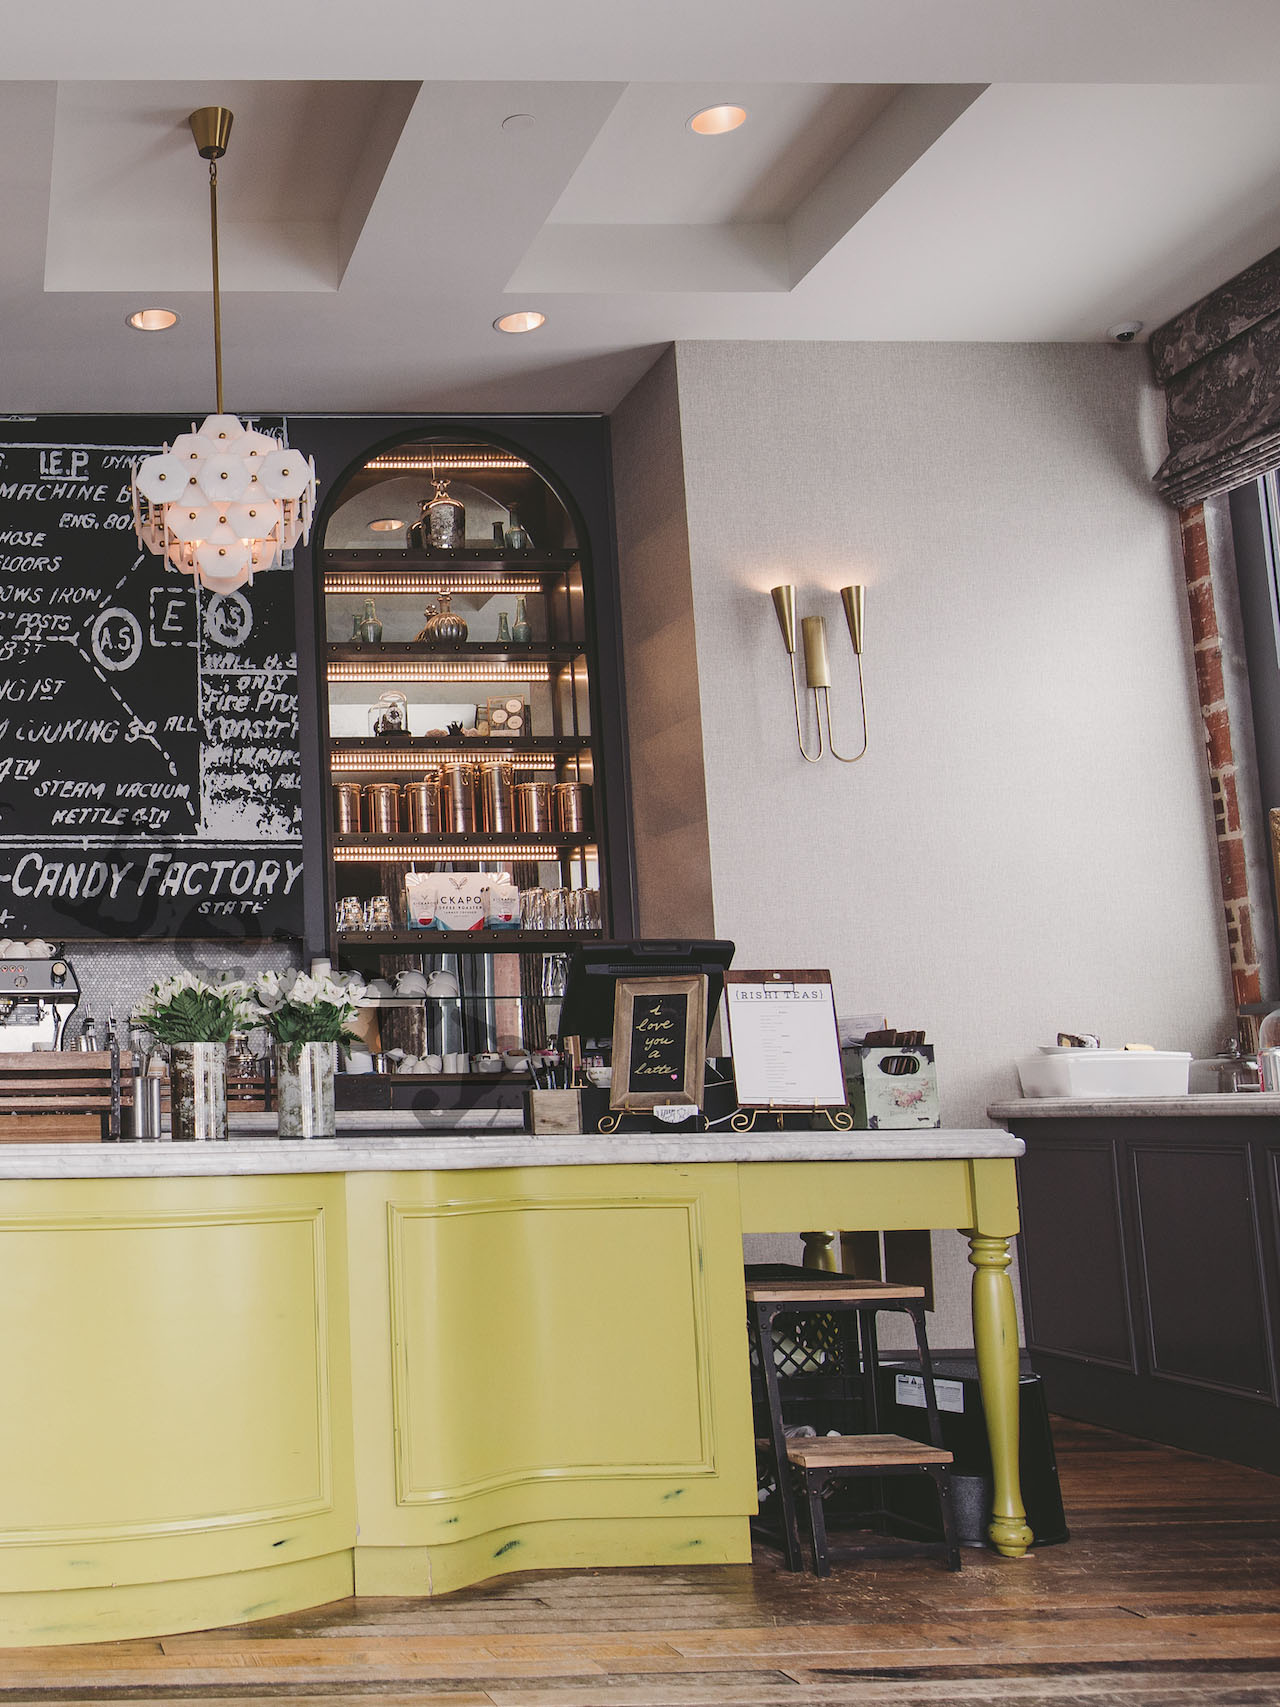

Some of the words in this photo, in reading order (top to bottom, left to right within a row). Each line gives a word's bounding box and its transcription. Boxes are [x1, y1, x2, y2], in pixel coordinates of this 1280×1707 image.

[162, 600, 186, 631] E
[162, 714, 198, 733] ALL
[34, 780, 105, 800] STEAM
[116, 782, 190, 799] VACUUM
[52, 808, 126, 825] KETTLE
[136, 852, 304, 897] FACTORY
[649, 1000, 662, 1016] i
[635, 1018, 675, 1032] love
[644, 1037, 675, 1051] you
[647, 1049, 661, 1059] a
[633, 1062, 679, 1075] latte
